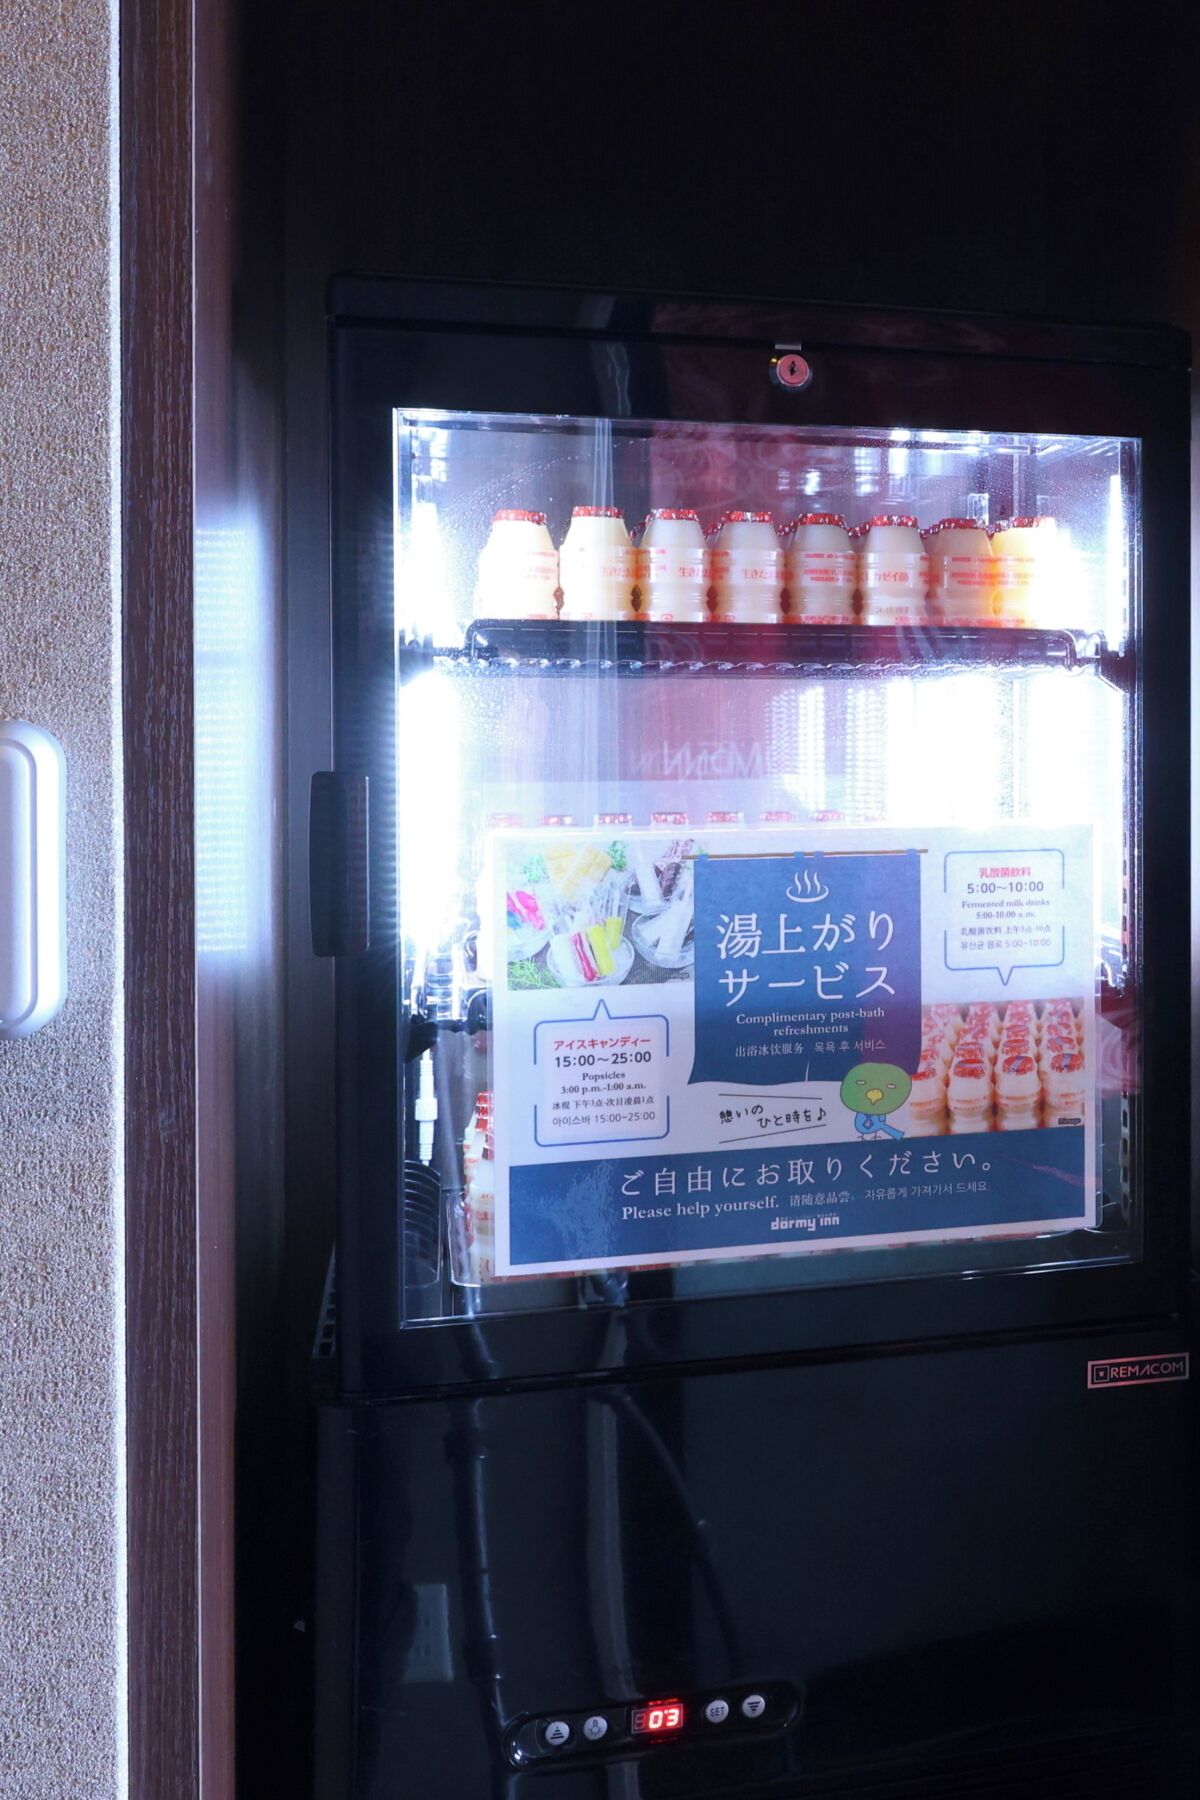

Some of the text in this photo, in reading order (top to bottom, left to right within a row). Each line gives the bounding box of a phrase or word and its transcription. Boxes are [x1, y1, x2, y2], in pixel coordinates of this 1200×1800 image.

[979, 867, 1031, 878] 乳酸菌飲料
[962, 899, 1050, 909] Fermented milk drinks
[716, 910, 894, 960] 湯上がり
[718, 961, 896, 1007] サービス
[736, 1007, 885, 1026] Complimentary post-bath
[773, 1024, 849, 1037] refreshments
[554, 1036, 652, 1051] アイスキャンディー
[813, 1039, 886, 1054] 목욕 후 서비스
[582, 1072, 626, 1082] Popsicles
[560, 1082, 646, 1095] 3:00 p.m.-1:00 a.m.
[552, 1115, 591, 1127] 아이스바
[719, 1104, 764, 1124] 憩いの
[621, 1150, 991, 1196] ご自由にお取りください。
[864, 1186, 908, 1202] 자유롭게
[622, 1196, 780, 1220] Please help yourself.
[771, 1215, 840, 1232] dormy inn
[1110, 1361, 1183, 1378] REMACOM
[710, 1706, 726, 1717] SET
